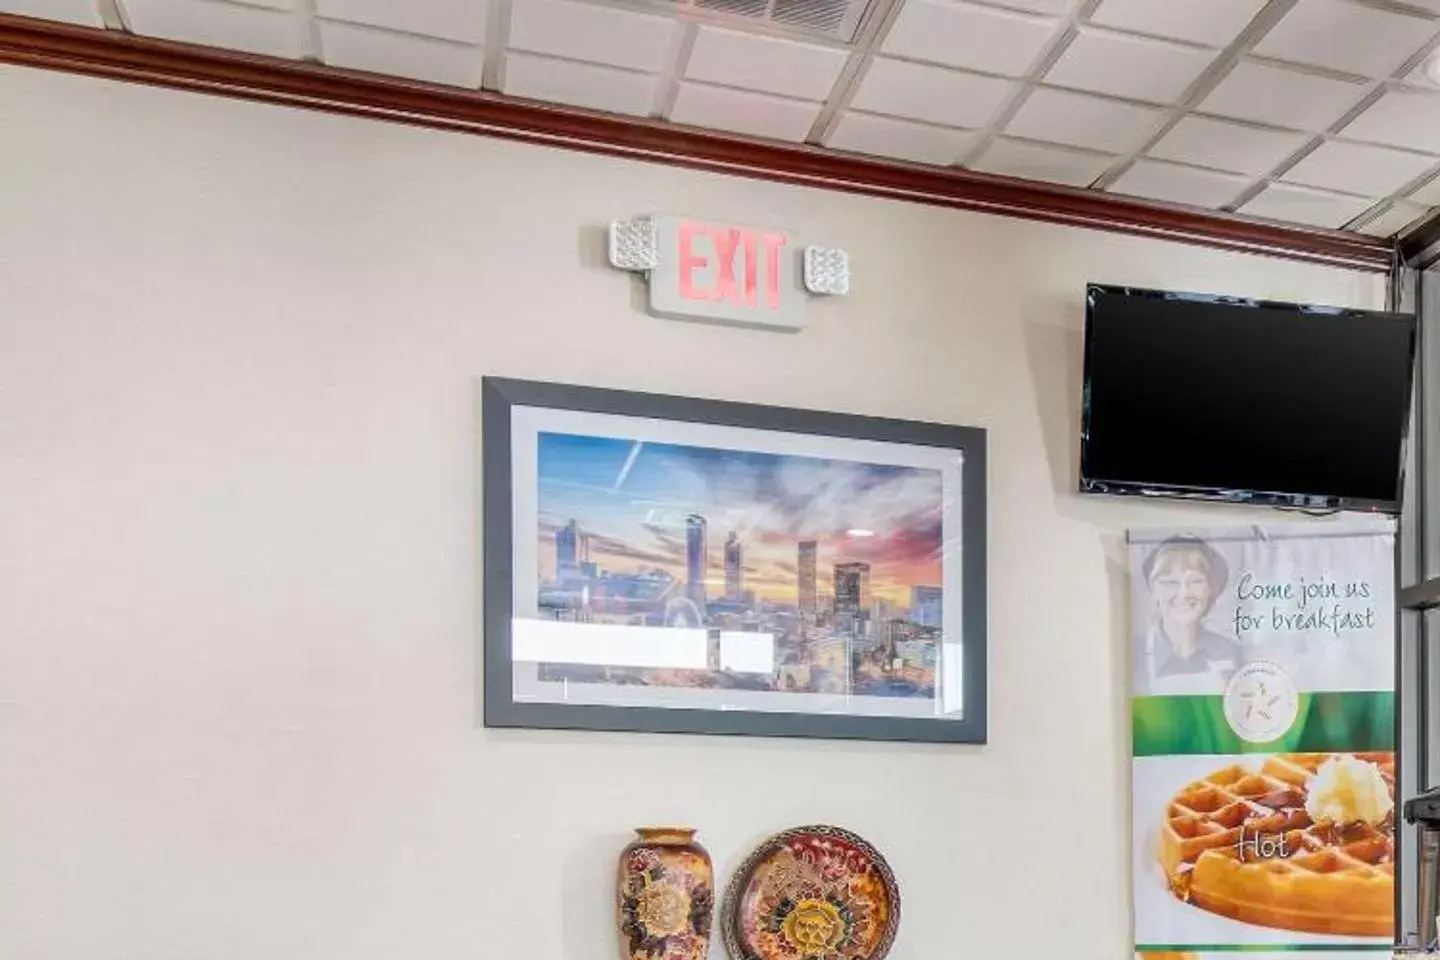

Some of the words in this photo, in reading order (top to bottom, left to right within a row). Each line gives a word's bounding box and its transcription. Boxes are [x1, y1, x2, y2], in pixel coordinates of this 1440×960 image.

[677, 218, 787, 310] EXIT
[1237, 572, 1295, 601] Come
[1297, 575, 1339, 610] join
[1345, 579, 1370, 599] us
[1232, 605, 1263, 640] for
[1272, 603, 1375, 638] breakfast
[1237, 824, 1290, 861] Hot
